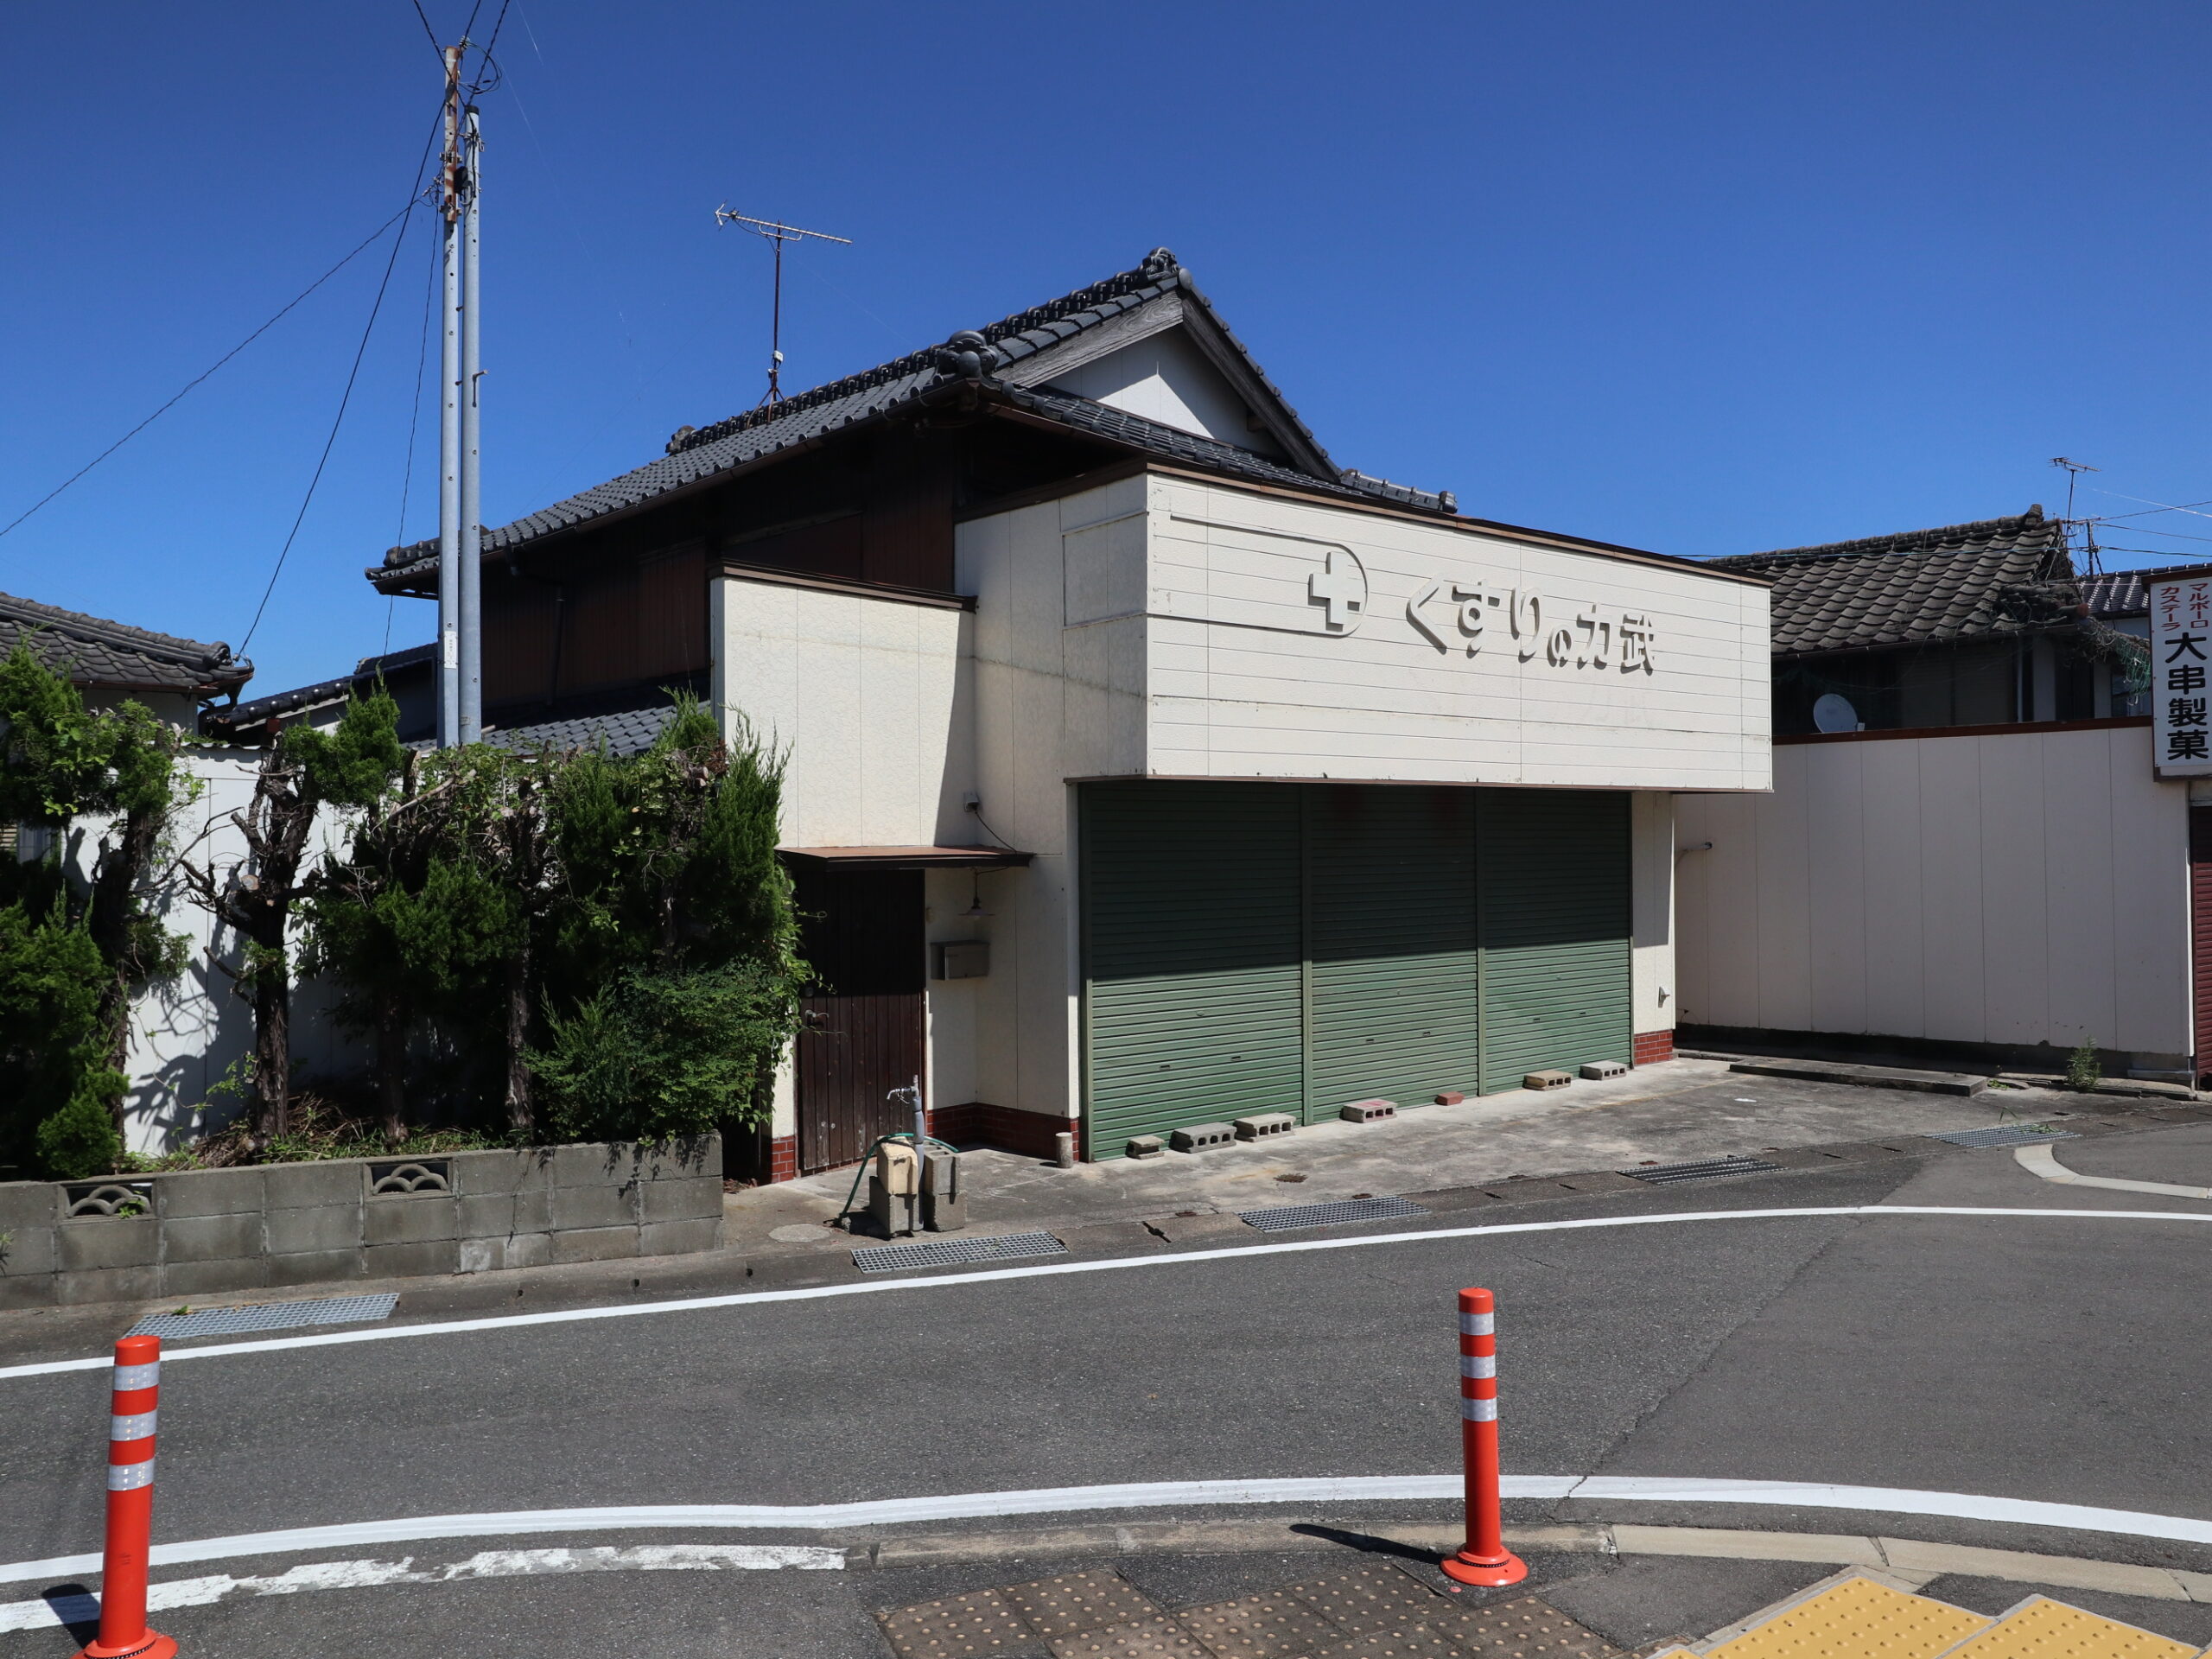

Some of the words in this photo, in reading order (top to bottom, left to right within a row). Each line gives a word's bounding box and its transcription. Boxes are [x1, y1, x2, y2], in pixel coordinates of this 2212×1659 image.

[1406, 575, 1656, 675] くすりの力武
[2160, 587, 2181, 632] カステーラ
[2189, 582, 2210, 629] マルボーロ
[2164, 632, 2209, 760] 大串製菓
